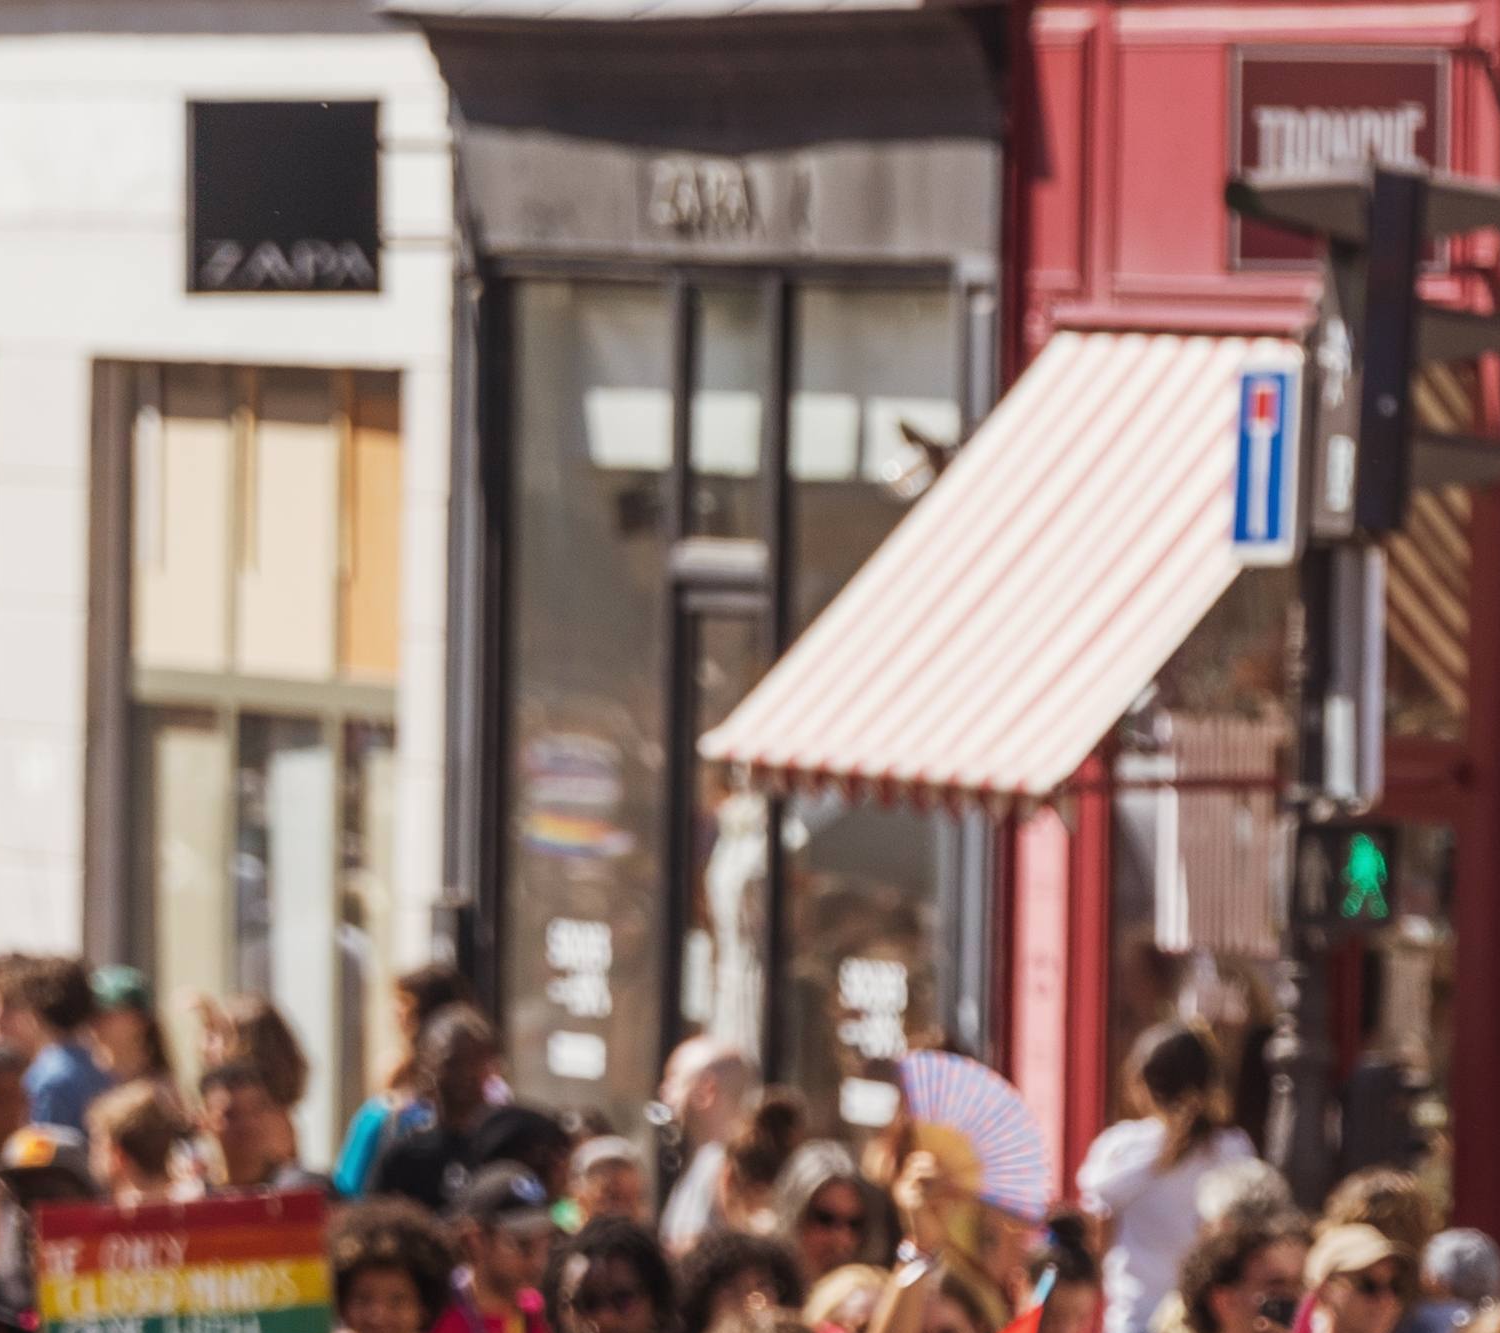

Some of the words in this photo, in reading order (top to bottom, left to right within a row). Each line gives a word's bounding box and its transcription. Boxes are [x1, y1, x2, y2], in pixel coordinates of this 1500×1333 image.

[199, 239, 376, 290] ZAPA
[98, 1232, 188, 1276] ONLY
[187, 1262, 300, 1312] MINDS
